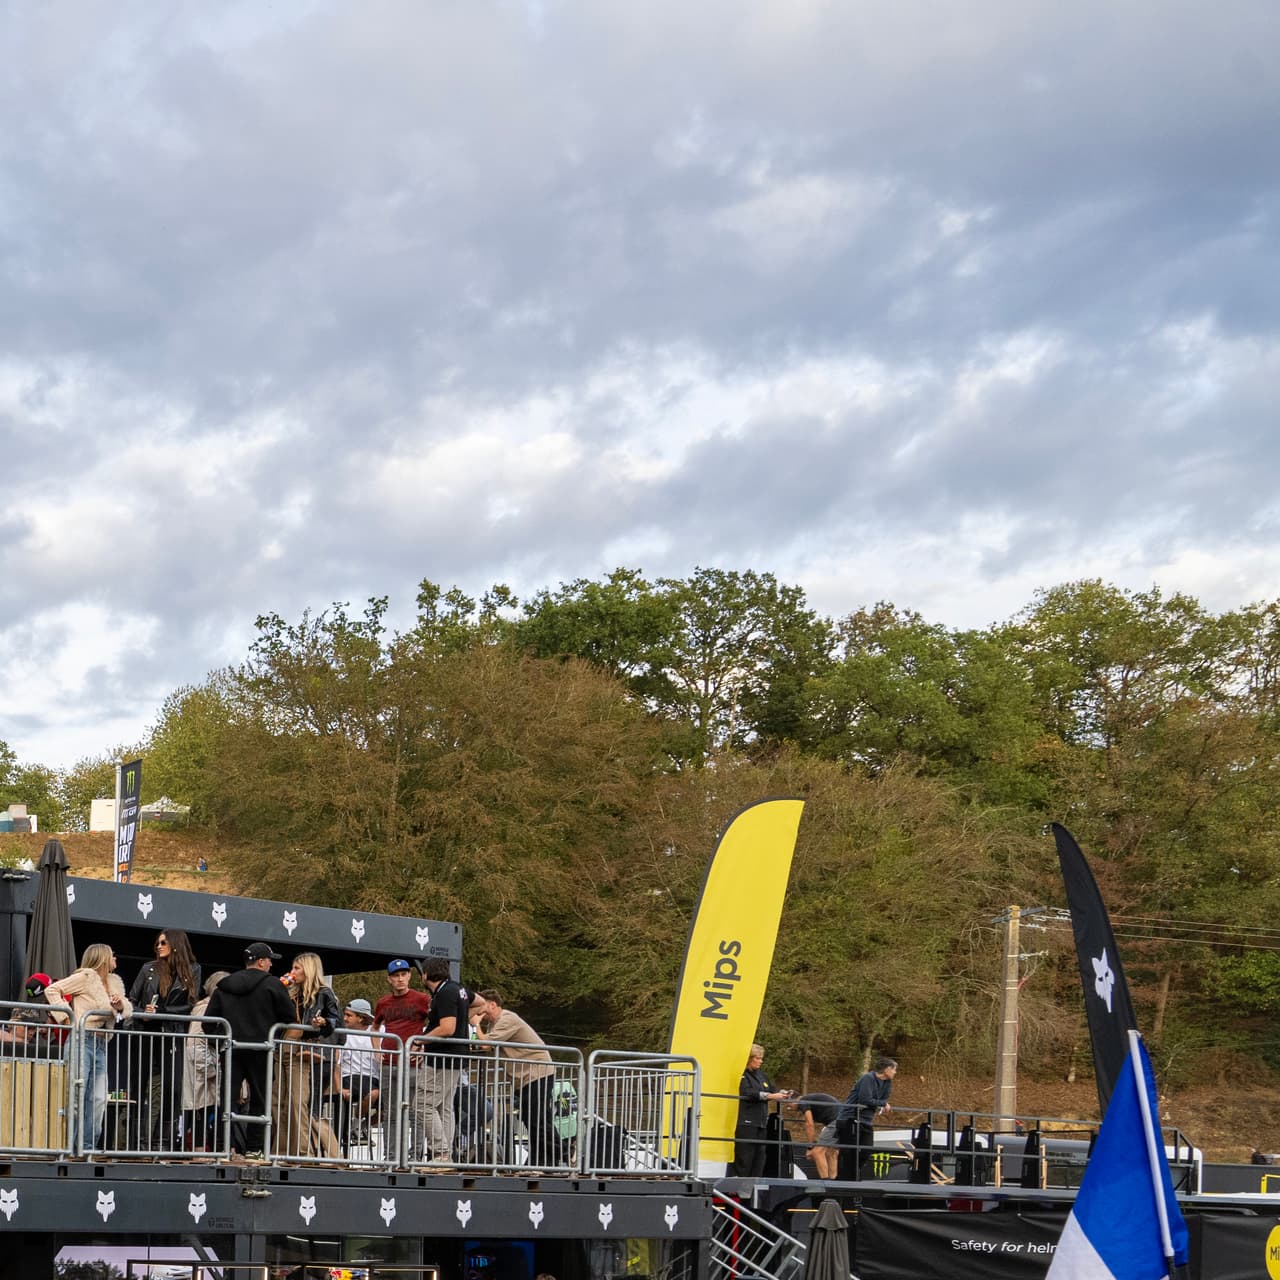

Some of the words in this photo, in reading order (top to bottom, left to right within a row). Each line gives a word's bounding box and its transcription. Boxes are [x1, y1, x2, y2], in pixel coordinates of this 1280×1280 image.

[701, 940, 742, 1020] Mips
[951, 1239, 996, 1254] Safety
[1001, 1240, 1022, 1253] for
